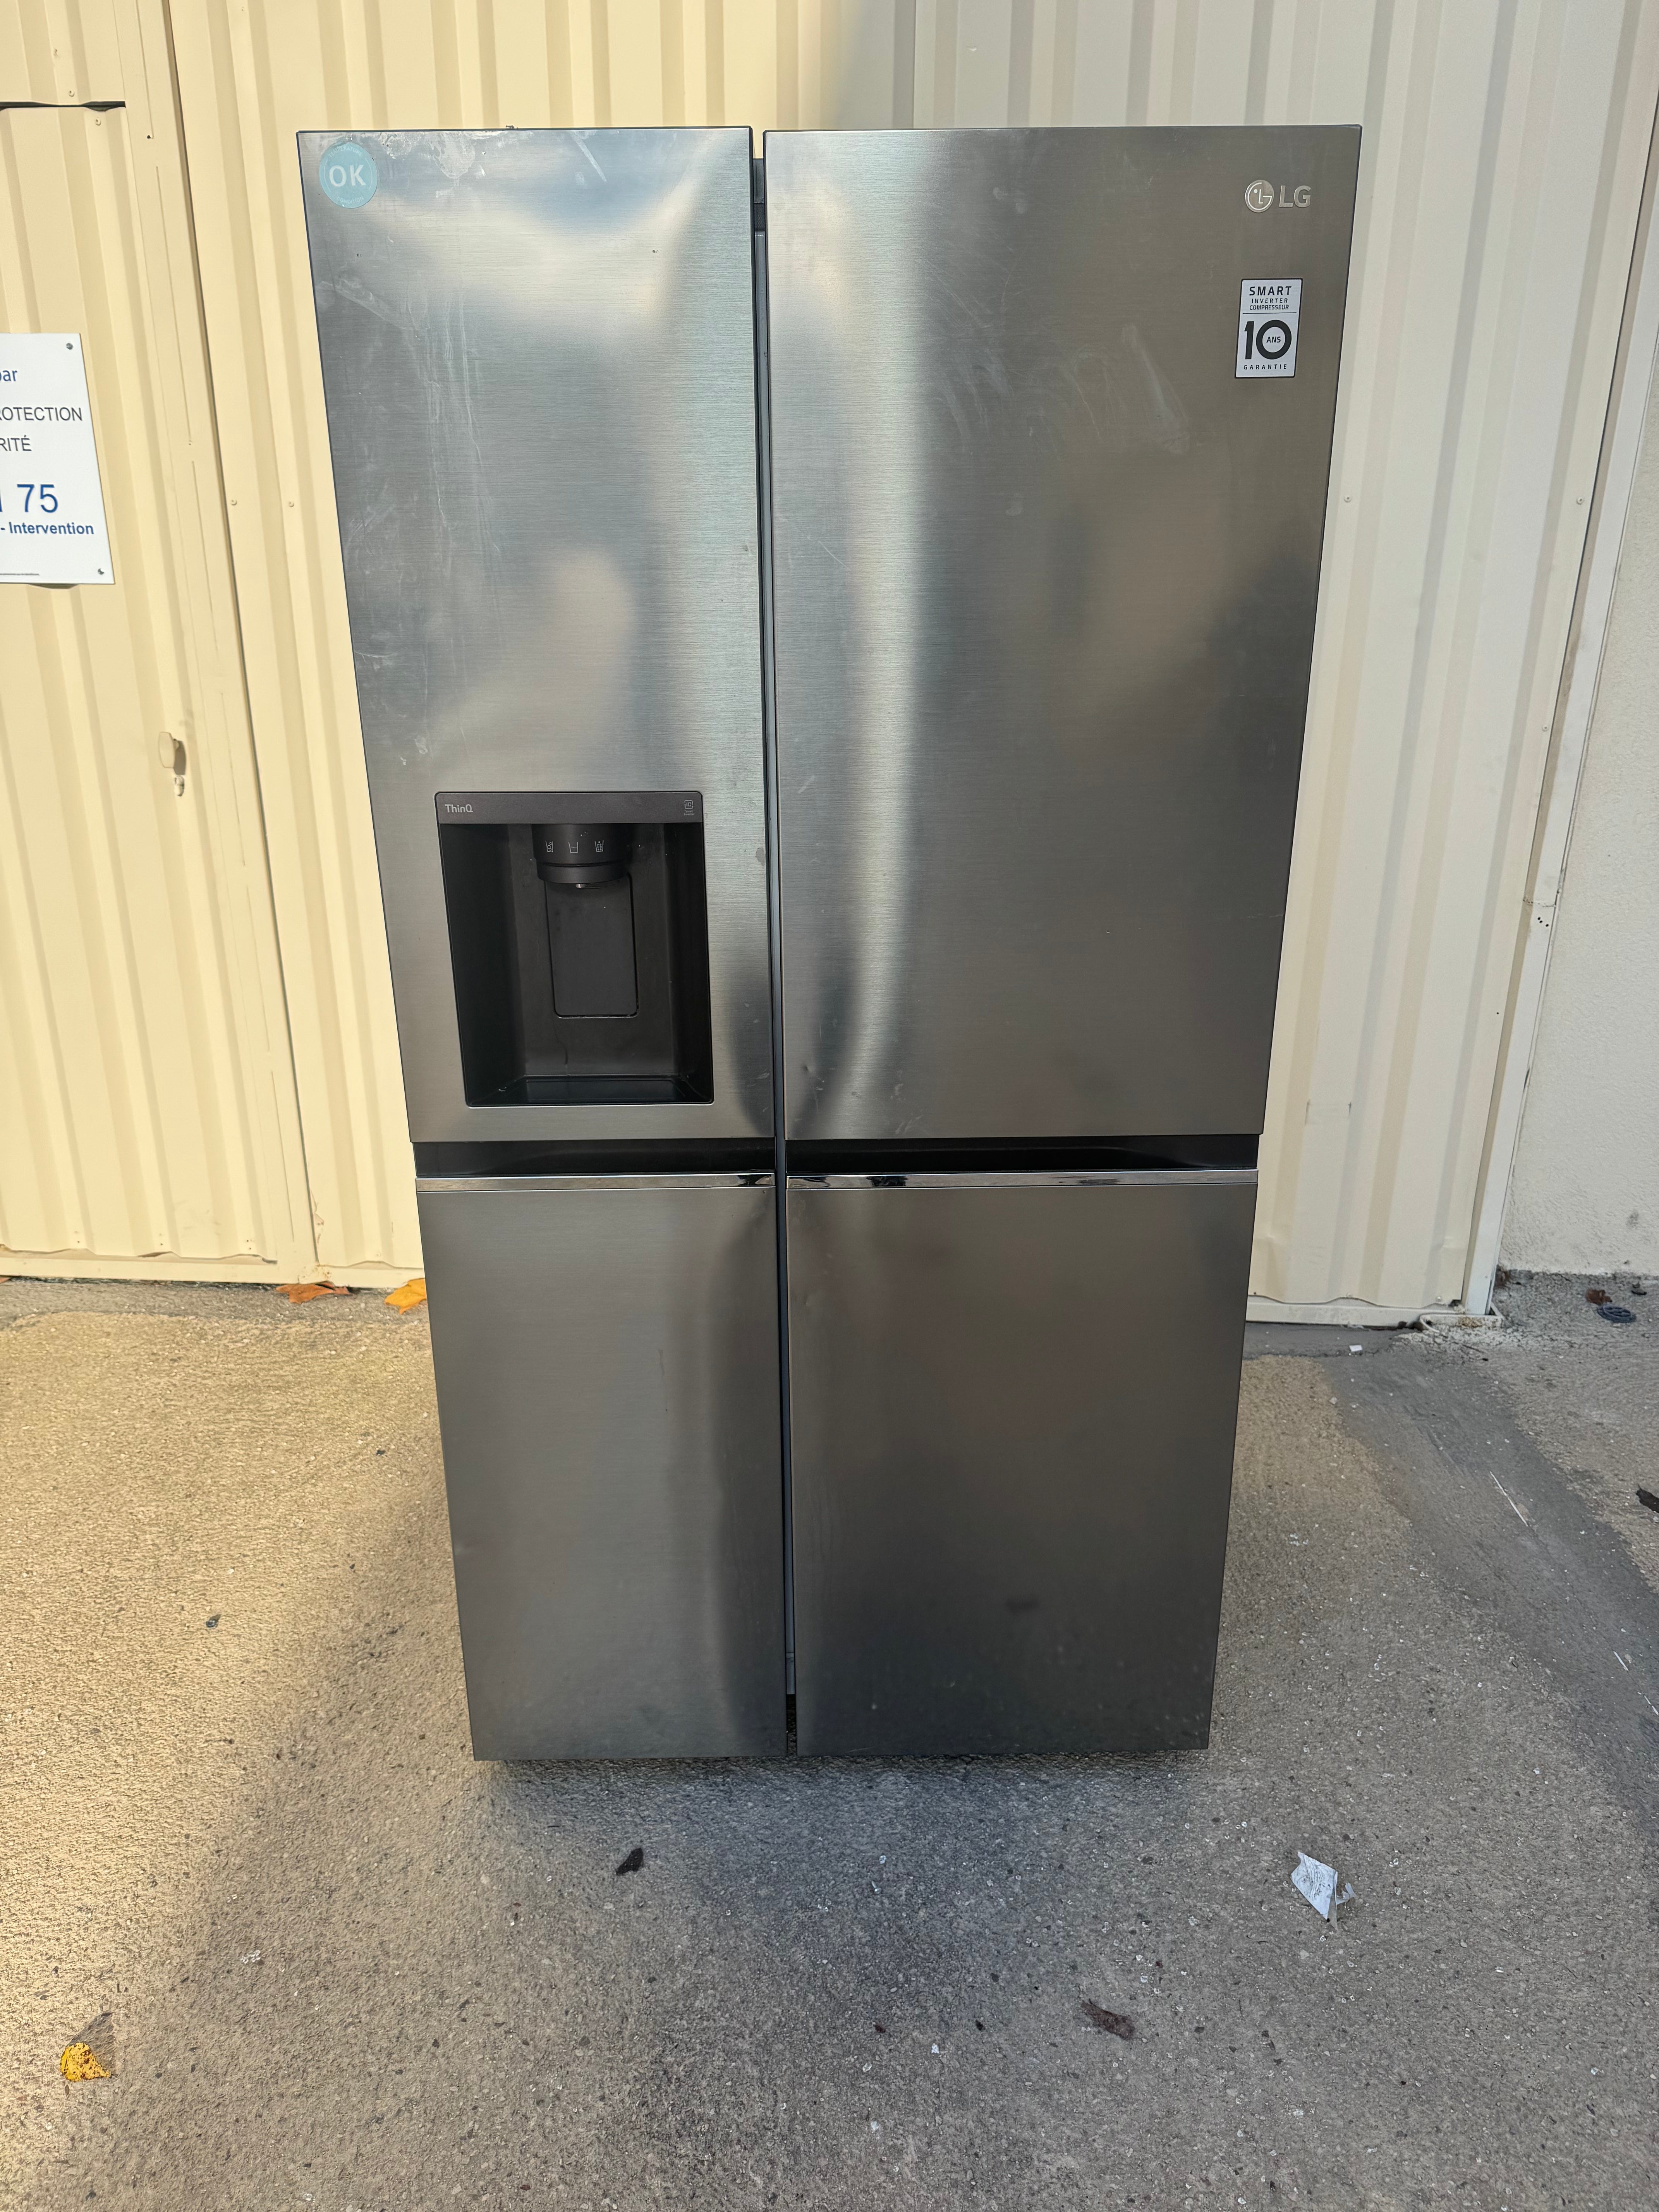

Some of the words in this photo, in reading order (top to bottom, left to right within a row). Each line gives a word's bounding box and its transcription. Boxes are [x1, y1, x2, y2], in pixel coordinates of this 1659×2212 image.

[329, 165, 366, 187] OK
[337, 196, 364, 204] CONDITION
[1279, 185, 1311, 208] LG
[1249, 286, 1291, 295] SMART
[1244, 319, 1292, 360] 10
[17, 484, 58, 513] 75
[9, 522, 94, 534] Intervention
[445, 804, 473, 812] ThinQ
